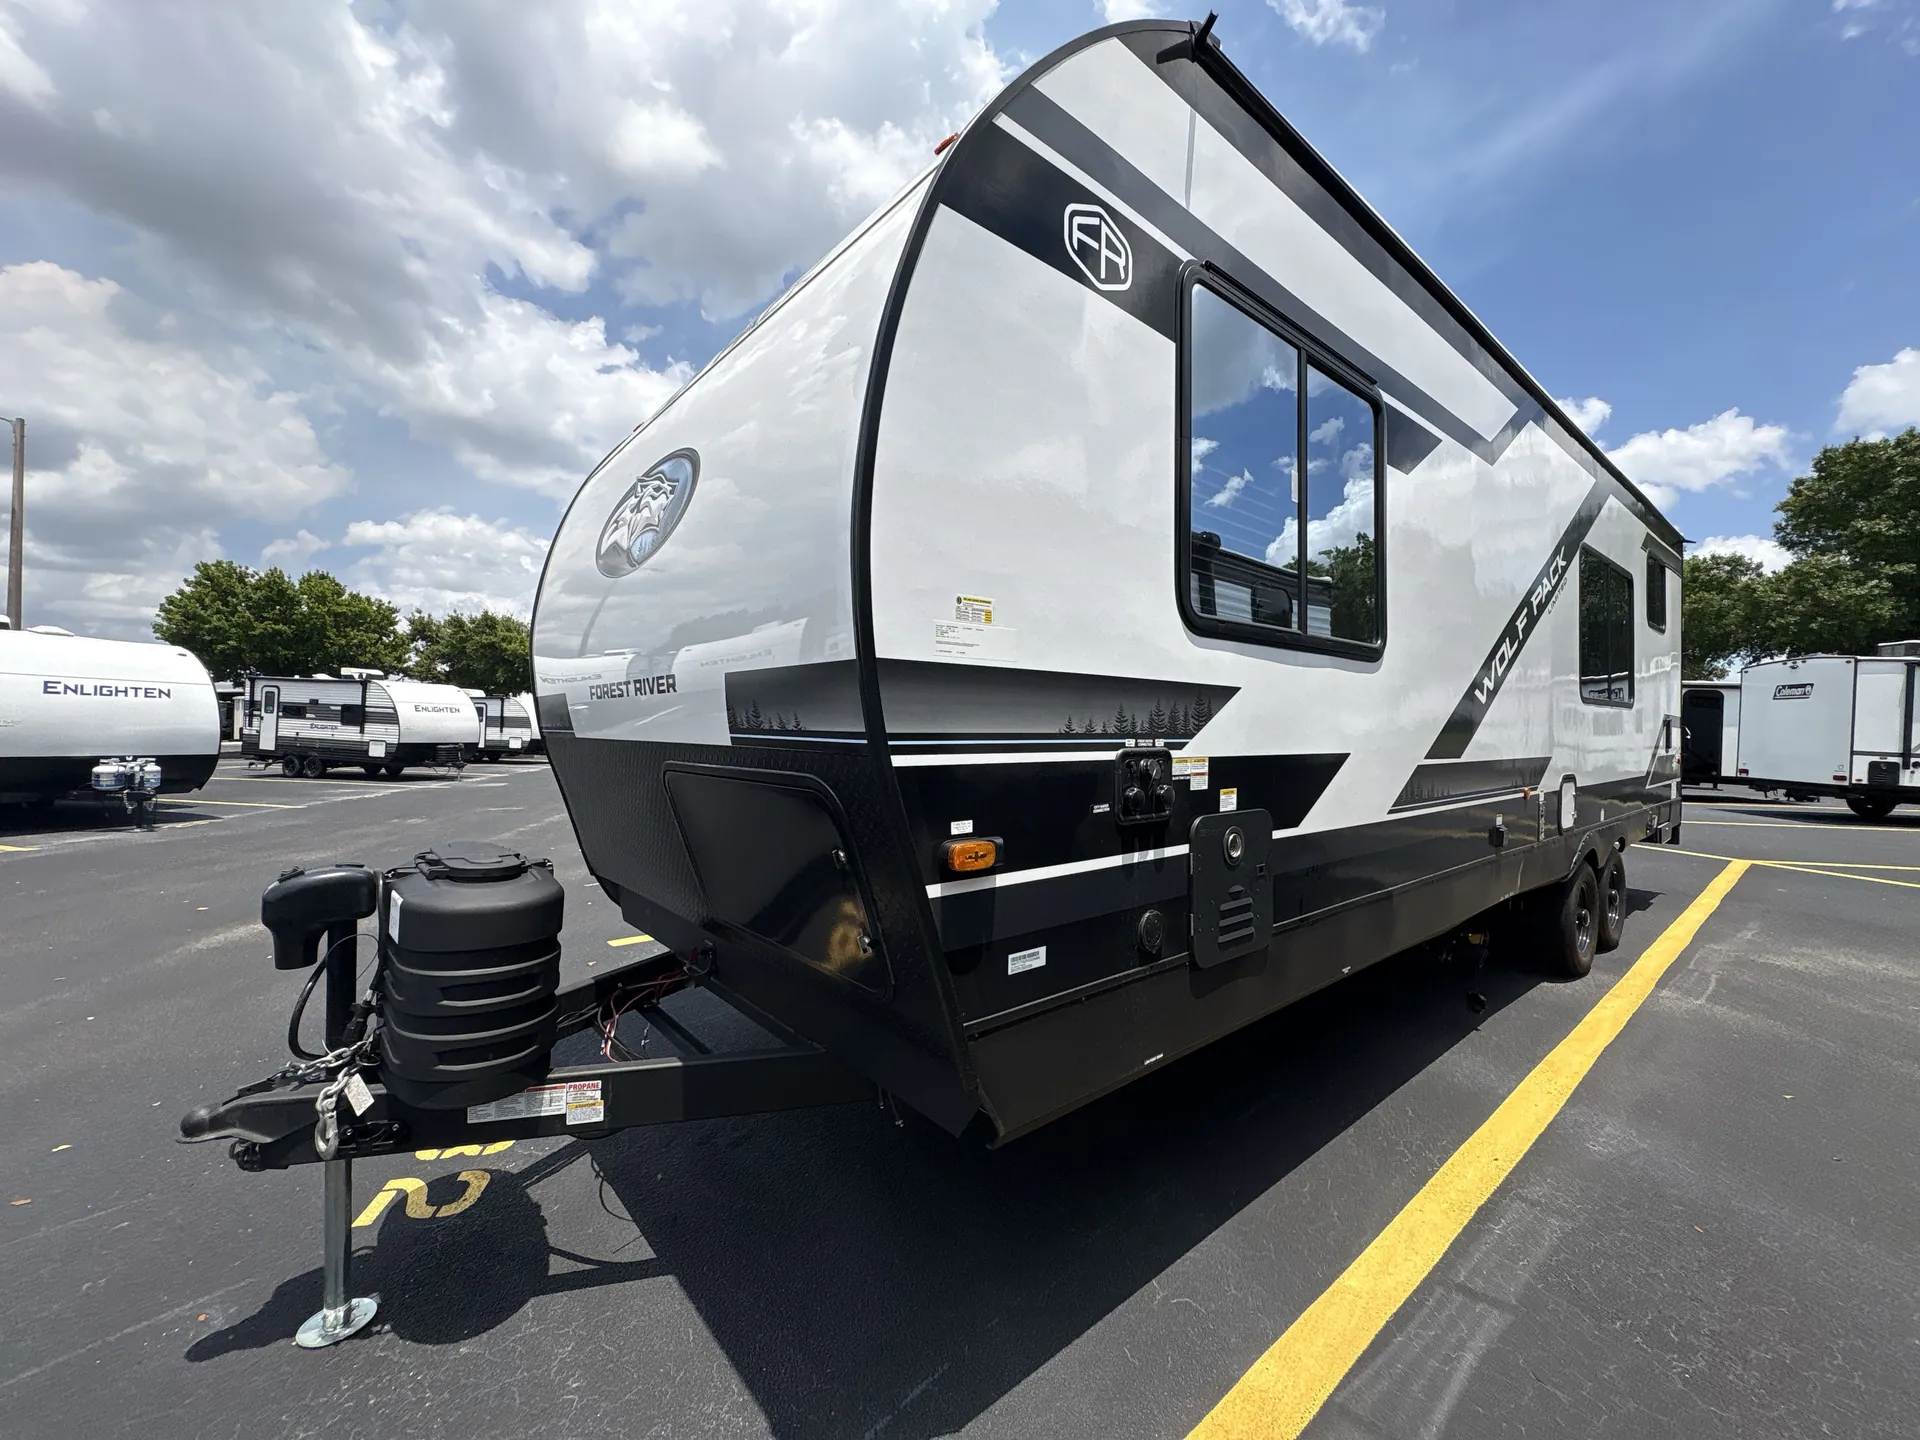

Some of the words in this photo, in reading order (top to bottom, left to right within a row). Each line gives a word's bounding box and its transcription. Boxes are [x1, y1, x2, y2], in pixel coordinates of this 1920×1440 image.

[1548, 577, 1568, 615] LIMITED
[1474, 607, 1528, 705] WOLF
[1530, 545, 1567, 616] PACK
[43, 680, 171, 699] ENLIGHTEN
[589, 681, 631, 700] FOREST
[633, 673, 677, 697] RIVER
[1776, 685, 1804, 697] Coleman
[414, 704, 461, 714] ENLIGHTEN
[568, 1082, 600, 1091] PROPANE
